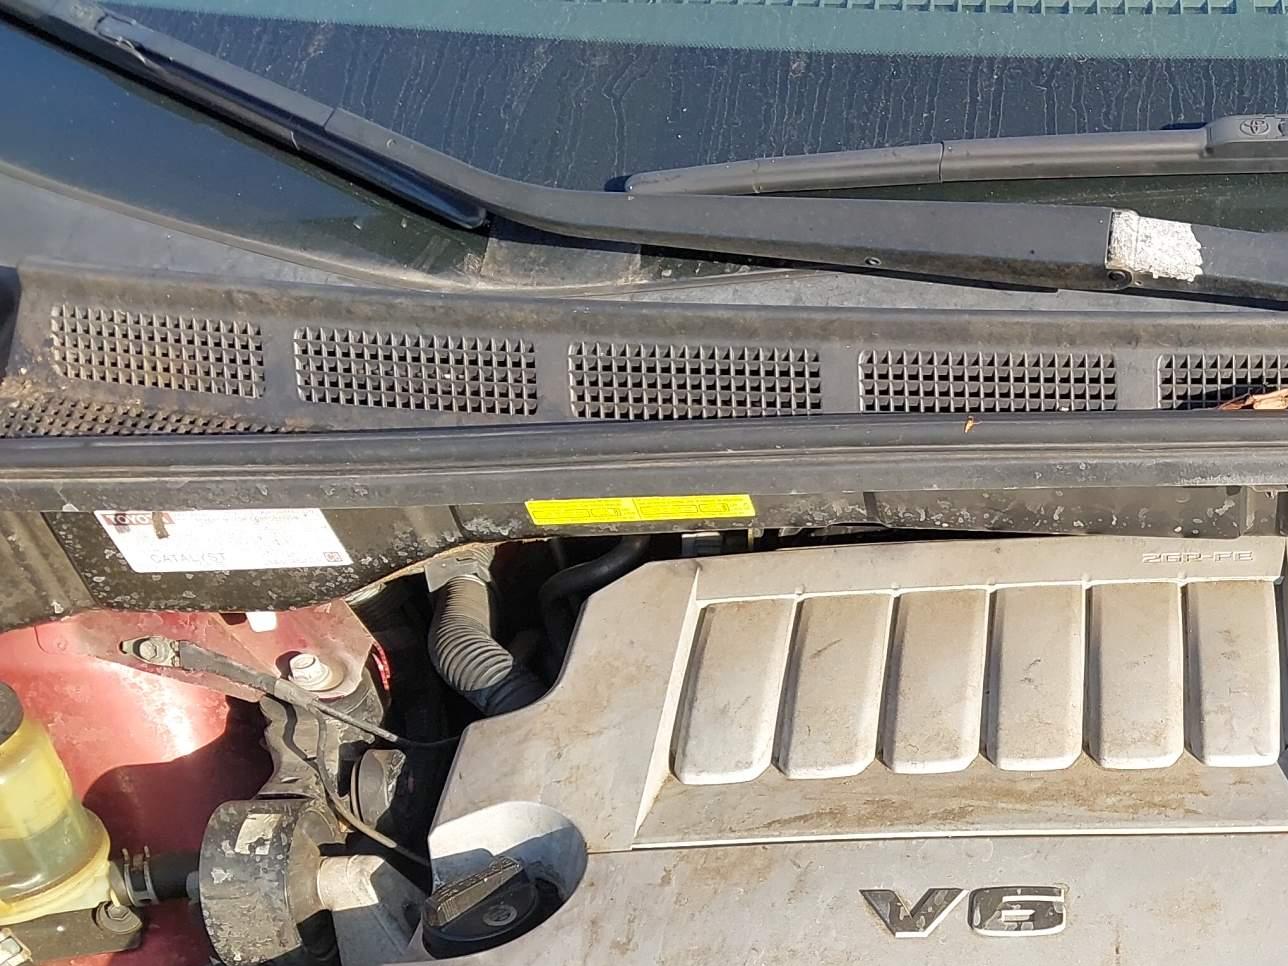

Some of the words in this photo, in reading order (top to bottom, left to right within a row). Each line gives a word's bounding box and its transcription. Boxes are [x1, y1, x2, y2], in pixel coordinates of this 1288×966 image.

[104, 514, 172, 525] TOYOA
[150, 552, 226, 564] CATALYST
[859, 885, 1068, 938] V6
